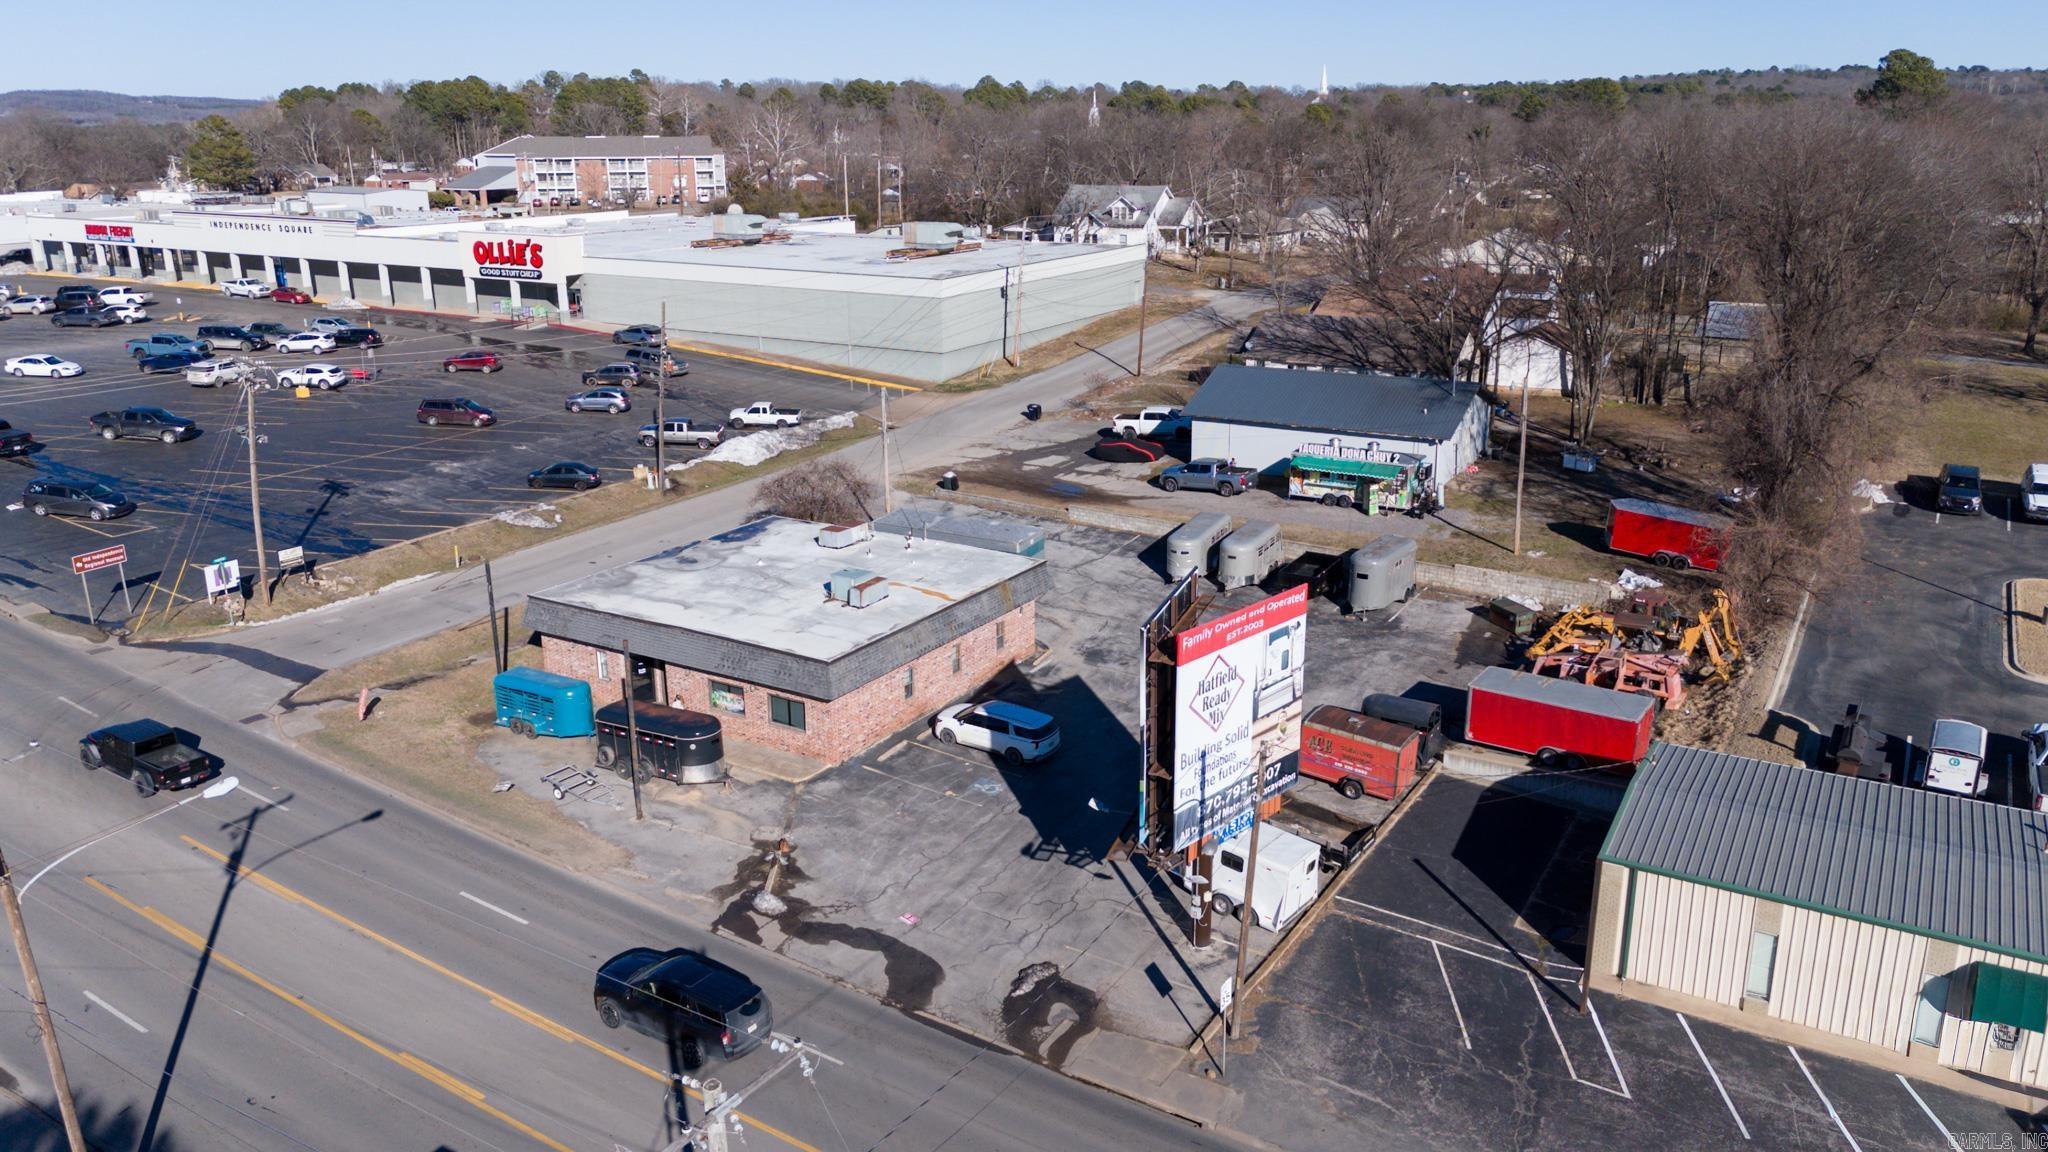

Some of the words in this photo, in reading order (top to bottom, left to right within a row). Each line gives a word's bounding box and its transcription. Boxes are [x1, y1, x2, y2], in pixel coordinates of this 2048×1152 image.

[209, 221, 271, 232] INDEPENDENCE
[279, 225, 313, 234] SQUARE
[1298, 444, 1340, 458] TAQUERIA
[1366, 450, 1392, 462] CHUY
[1392, 453, 1400, 464] 2
[1182, 627, 1213, 651] Family
[1215, 613, 1247, 632] Owned
[1248, 606, 1265, 618] and
[1266, 590, 1306, 612] Operated
[1198, 665, 1237, 696] Hatfield
[1202, 688, 1231, 712] Ready
[1208, 708, 1226, 724] Mix
[1225, 724, 1249, 745] Solid
[1180, 785, 1196, 798] For
[1218, 758, 1249, 780] future
[1194, 750, 1237, 779] Fondations
[1197, 762, 1282, 817] 70.793.507
[1260, 771, 1297, 799] xcavation
